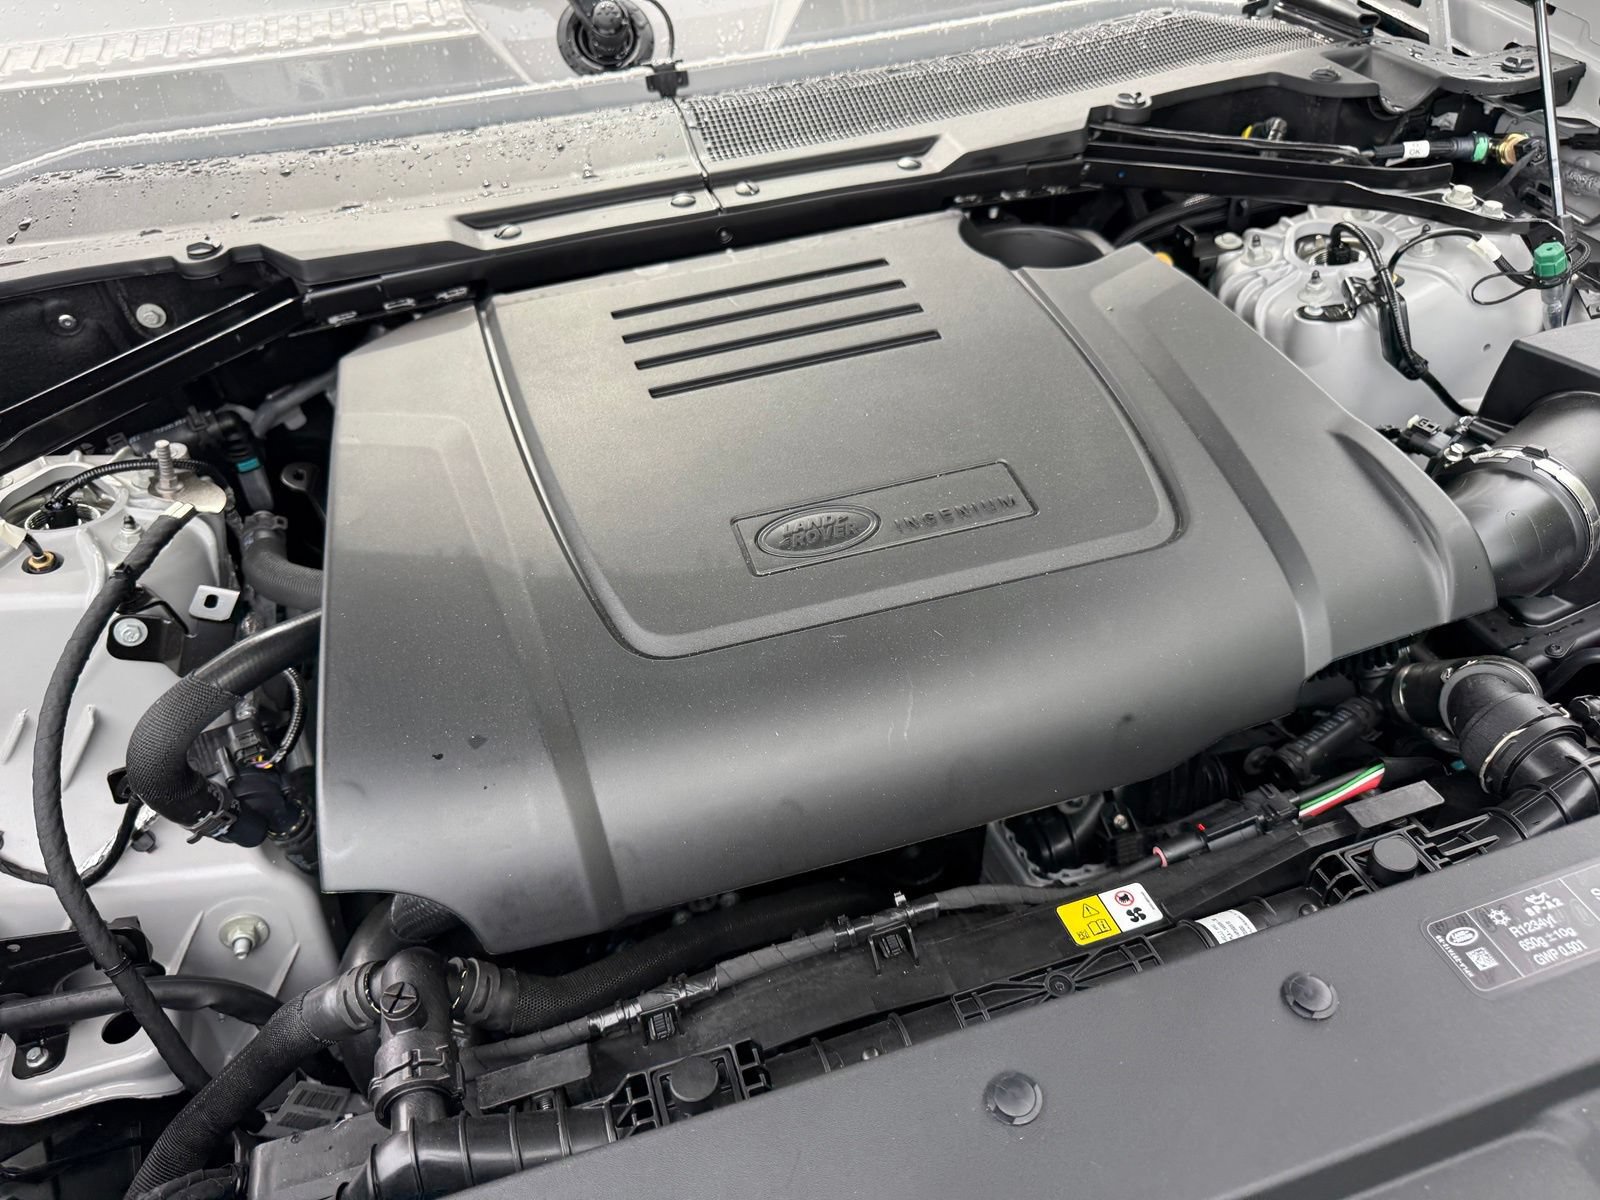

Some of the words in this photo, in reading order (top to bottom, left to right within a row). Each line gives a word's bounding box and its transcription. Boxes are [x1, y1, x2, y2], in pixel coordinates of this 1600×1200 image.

[783, 515, 837, 538] LAND
[894, 494, 1016, 533] INGENIUM
[790, 522, 859, 548] ROVER
[1518, 936, 1550, 952] 650g
[1533, 948, 1559, 966] GWP
[1557, 938, 1588, 957] 0.501
